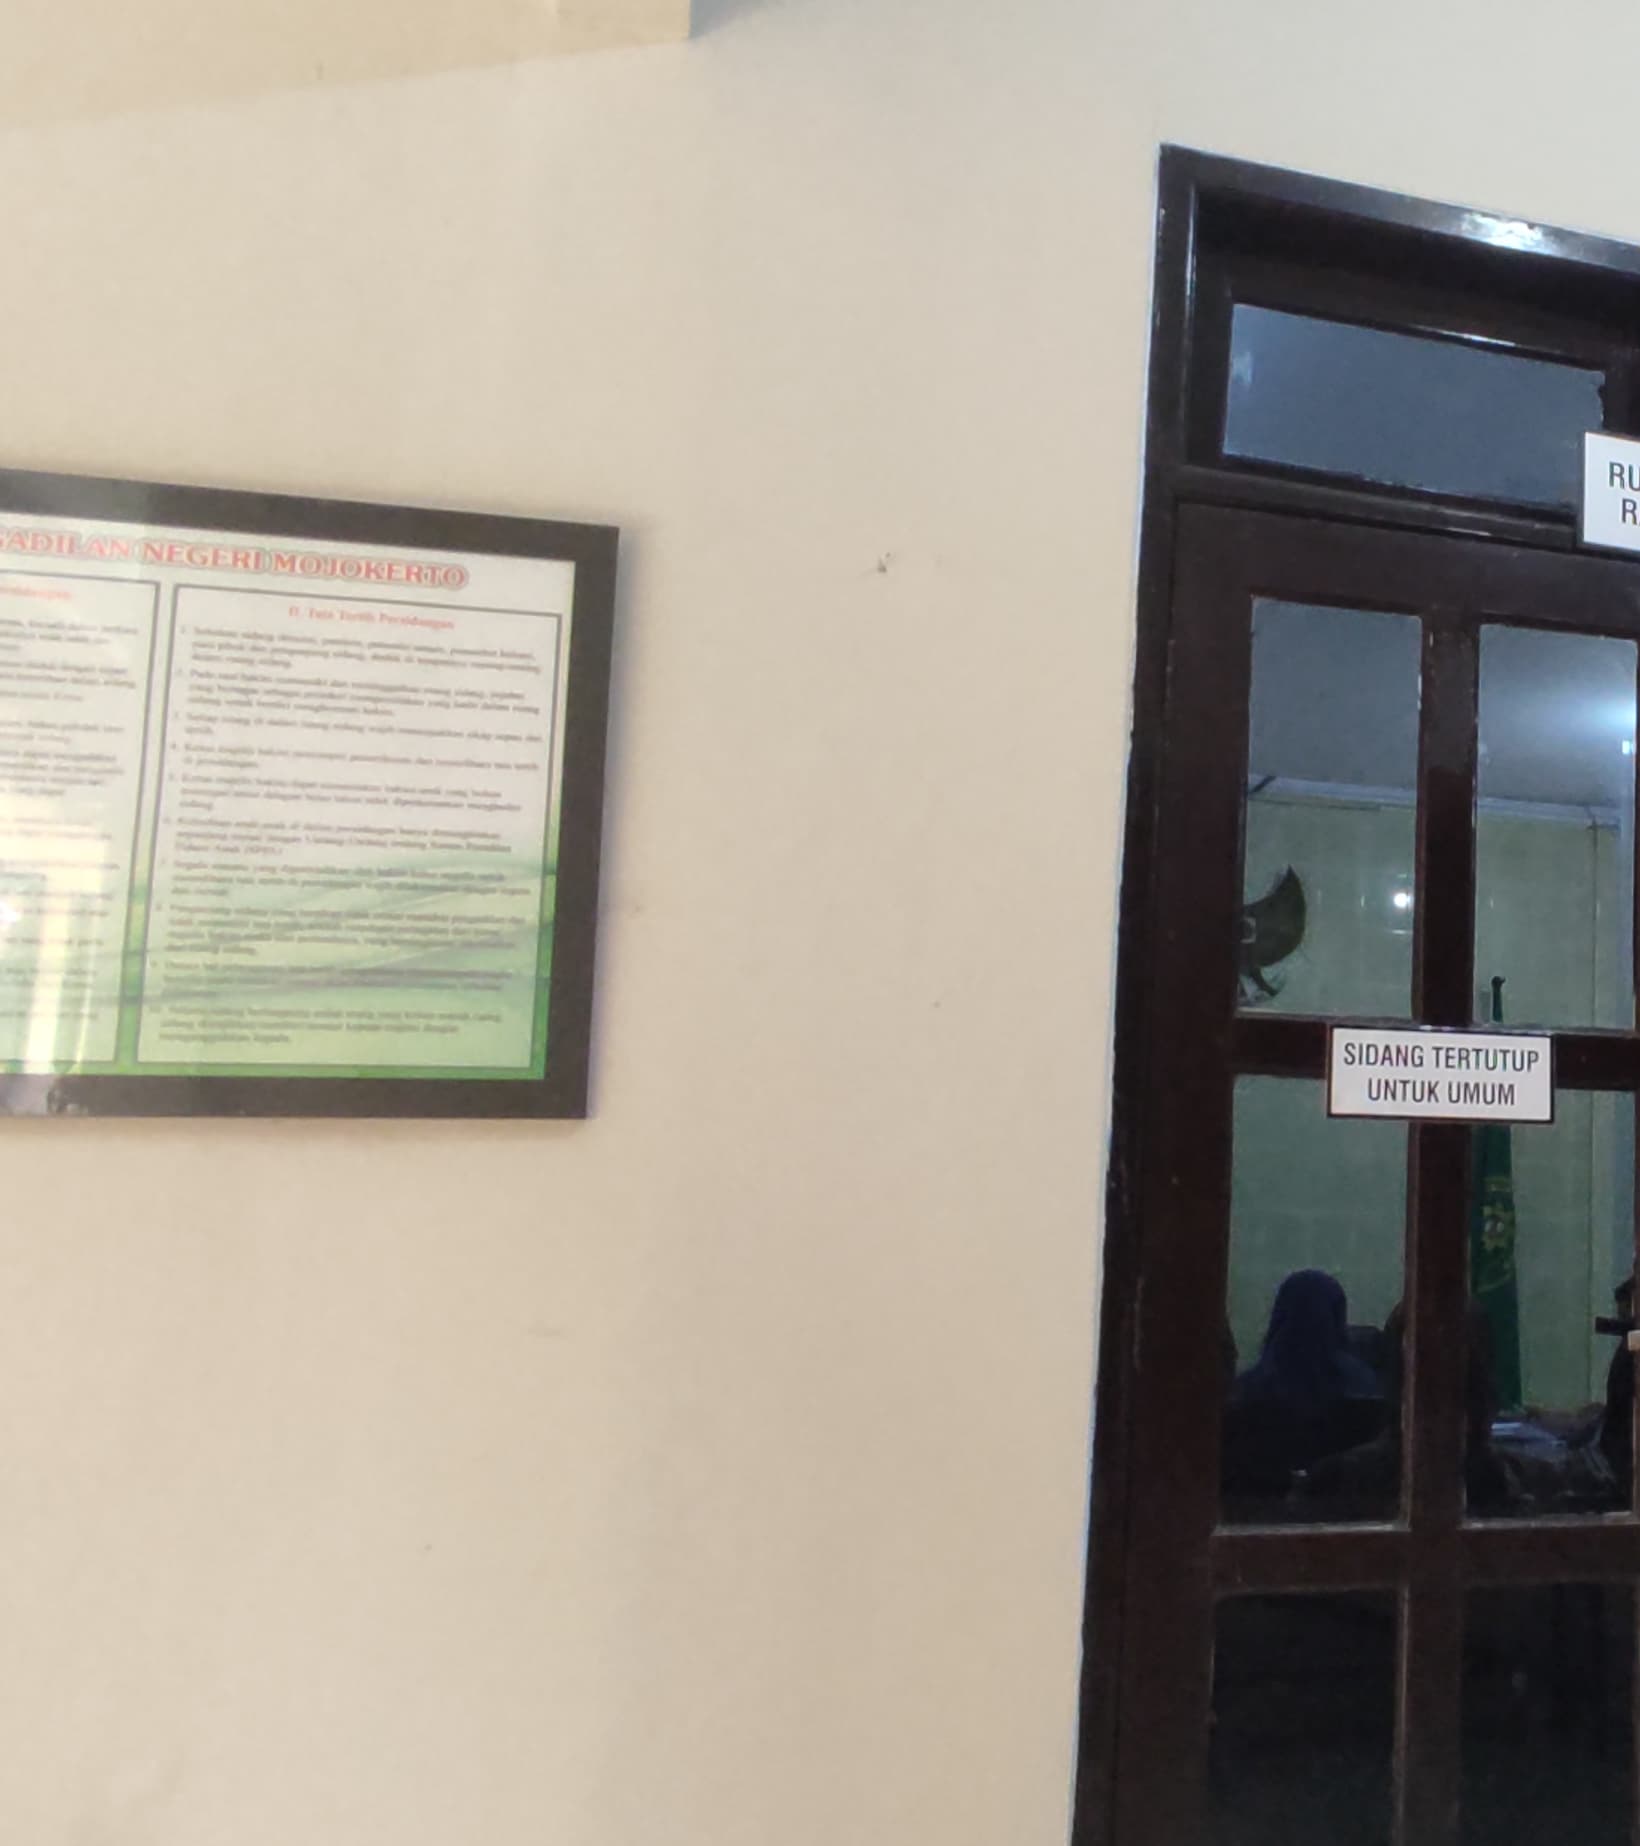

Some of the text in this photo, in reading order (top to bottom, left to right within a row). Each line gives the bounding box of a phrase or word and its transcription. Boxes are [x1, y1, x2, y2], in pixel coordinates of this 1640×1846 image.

[0, 529, 467, 587] ADILAN NEGERI MOJOKERTO
[1343, 1042, 1540, 1073] SIDANG TERTUTUP
[1367, 1078, 1516, 1106] UNTUK UMUM
